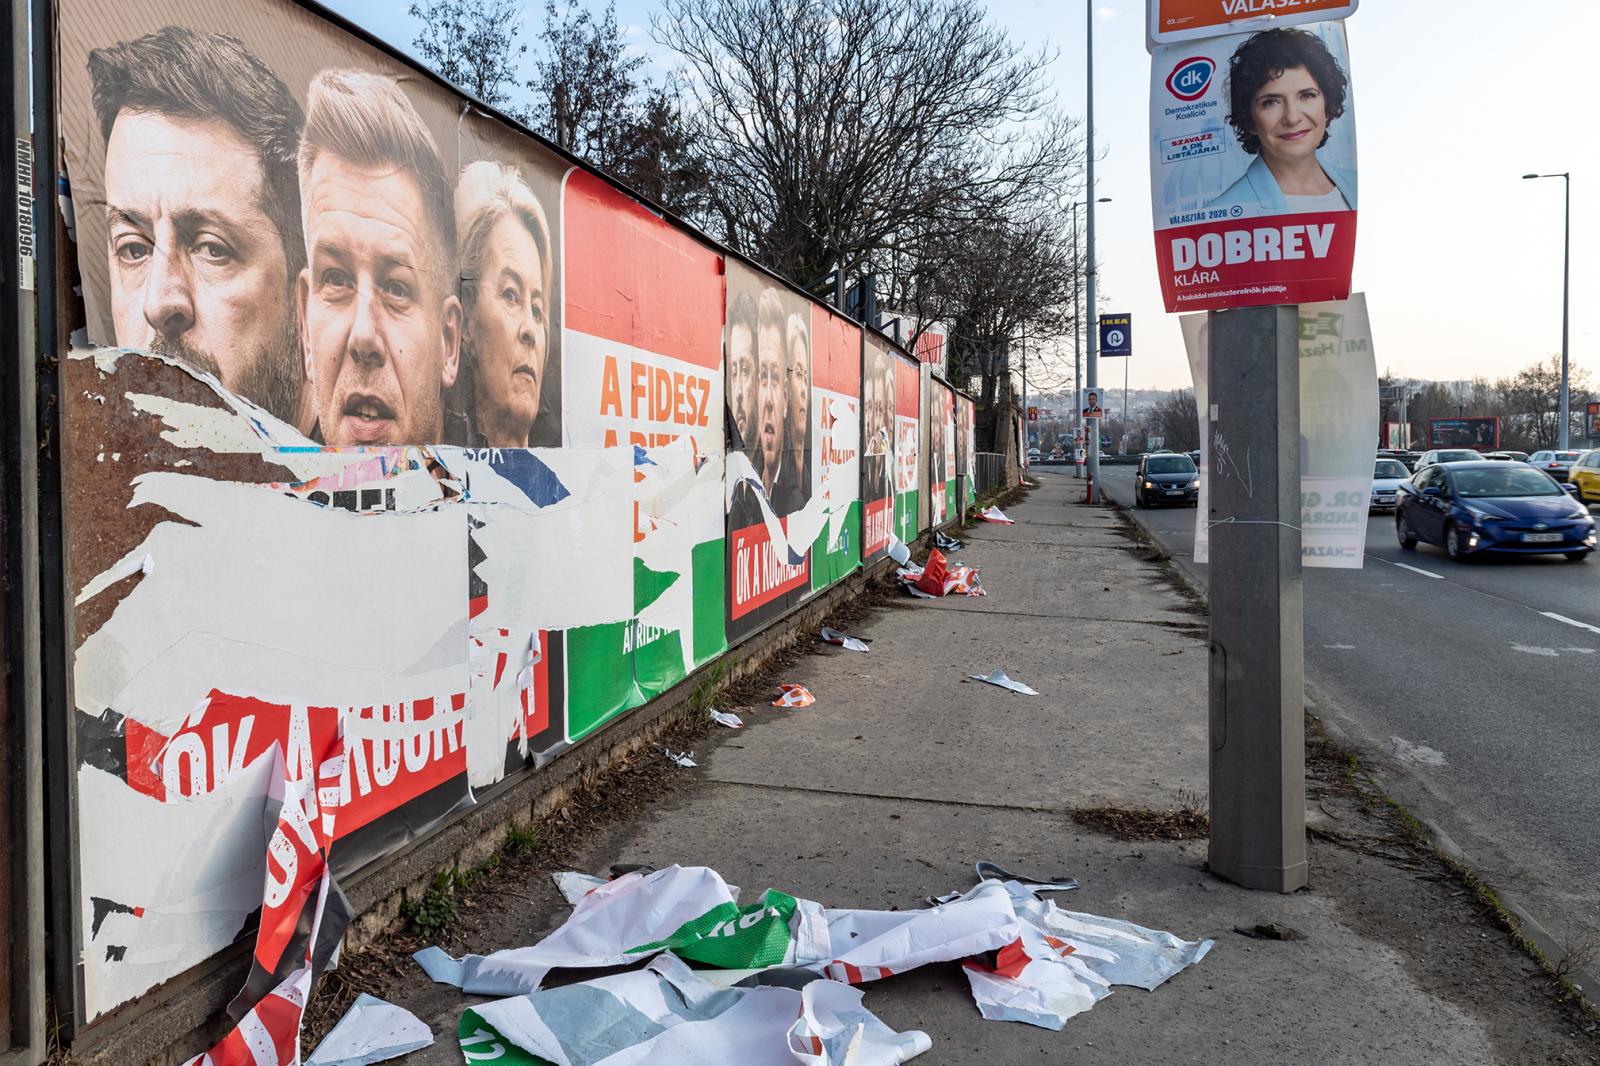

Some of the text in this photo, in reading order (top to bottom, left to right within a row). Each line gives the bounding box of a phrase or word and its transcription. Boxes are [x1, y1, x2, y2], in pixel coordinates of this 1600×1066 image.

[1181, 69, 1203, 88] dk
[1165, 100, 1218, 116] Demokratikus
[1176, 108, 1206, 120] Koalíció
[1171, 133, 1213, 147] SZAVAZZ
[1190, 142, 1204, 150] DK
[1167, 145, 1220, 161] LISTÁJÁRA!
[17, 140, 32, 257] NMHH 1018096
[1169, 210, 1206, 225] VÁLASZTÁS
[1171, 223, 1336, 272] DOBREV
[1174, 270, 1220, 287] KLÁRA
[600, 355, 710, 427] A FIDESZ
[736, 538, 750, 605] ŐK
[752, 544, 760, 597] A
